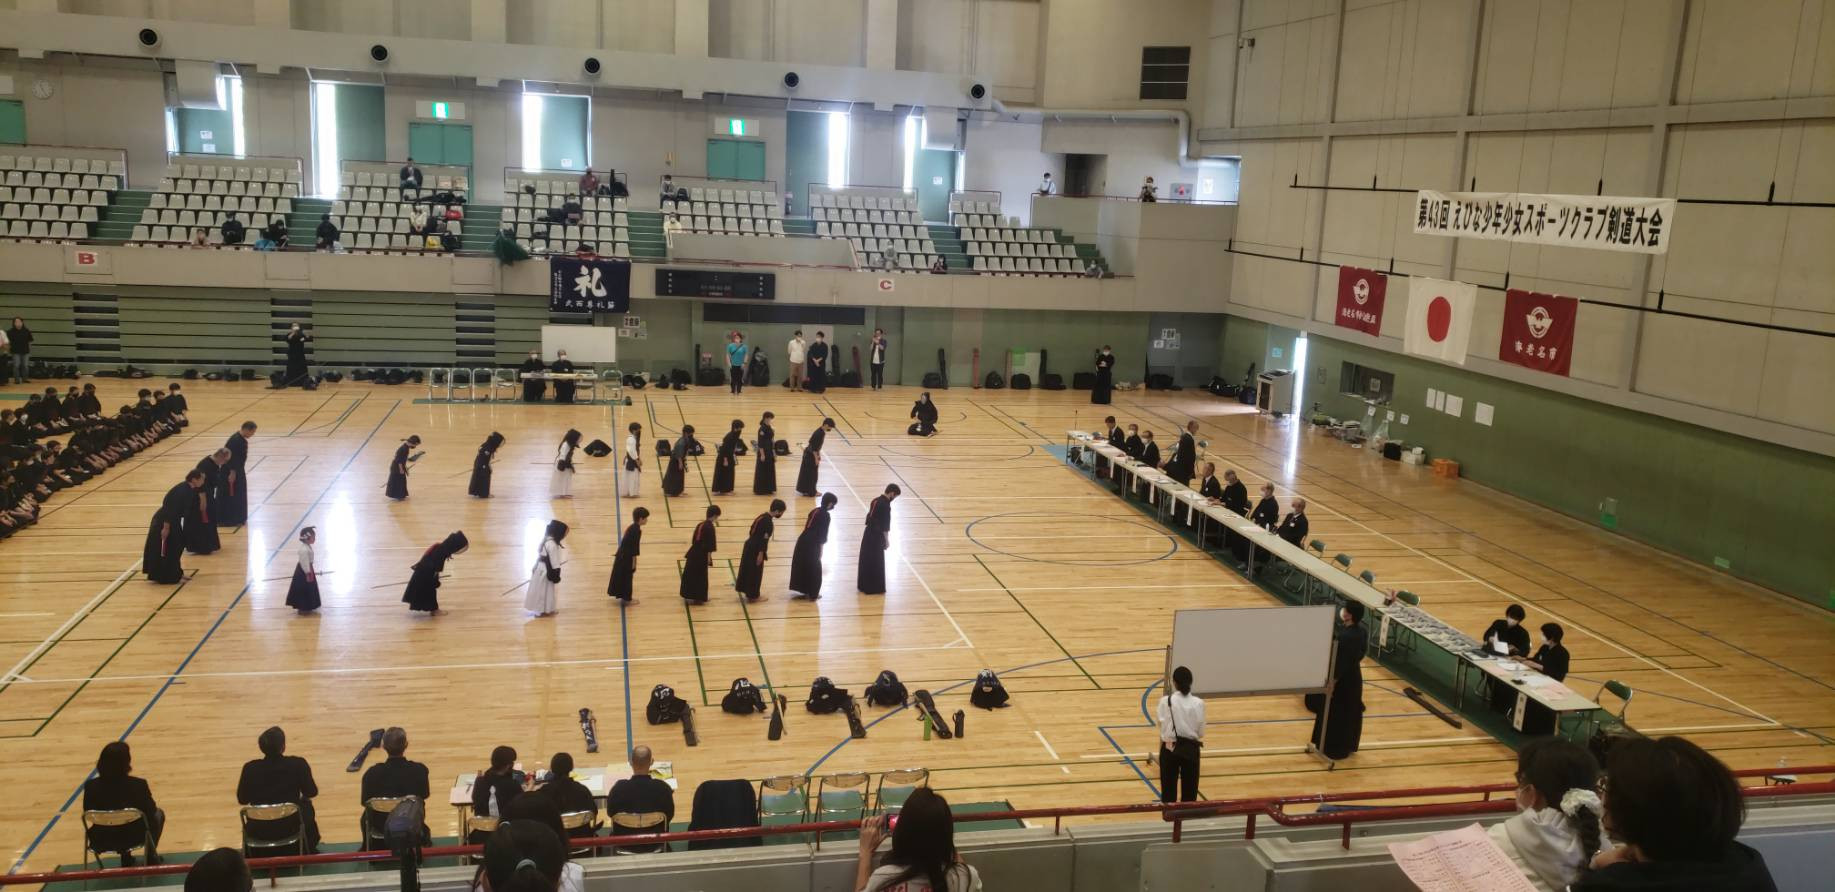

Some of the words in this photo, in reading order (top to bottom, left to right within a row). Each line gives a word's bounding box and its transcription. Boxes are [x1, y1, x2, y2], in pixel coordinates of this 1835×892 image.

[1417, 197, 1451, 230] 第43回
[79, 253, 95, 264] B
[572, 264, 608, 298] 礼
[880, 280, 892, 290] C
[1514, 341, 1558, 361] 海老名市
